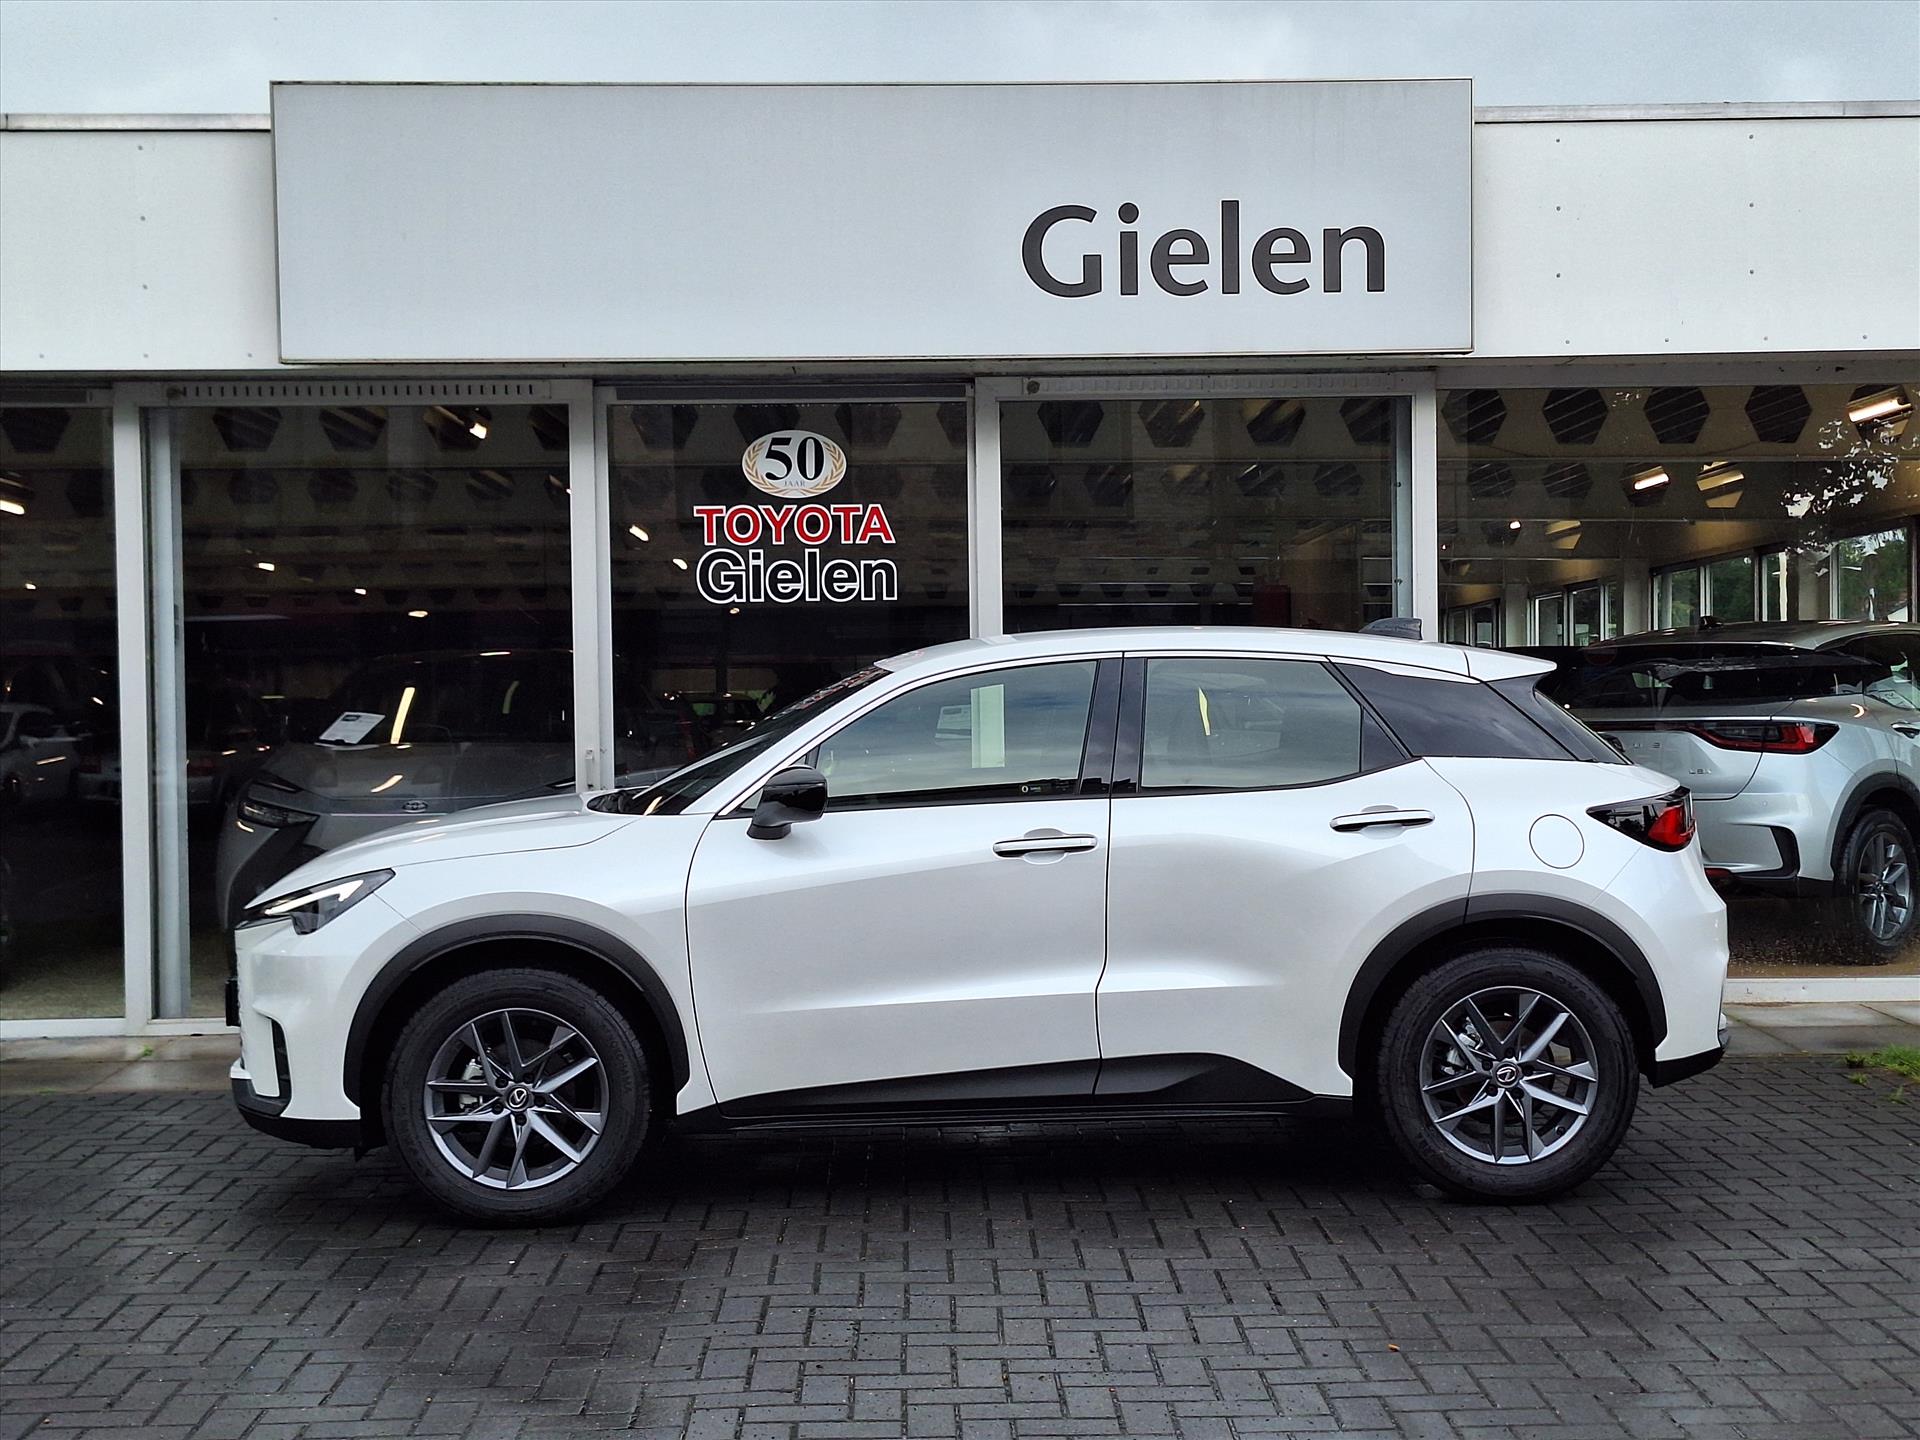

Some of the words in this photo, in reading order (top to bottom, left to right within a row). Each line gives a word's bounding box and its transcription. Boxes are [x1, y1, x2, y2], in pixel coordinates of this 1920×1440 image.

[1022, 200, 1385, 298] Gielen
[765, 436, 825, 481] 50
[784, 480, 806, 488] JAAR
[693, 504, 896, 546] TOYOTA
[696, 548, 898, 605] Gielen
